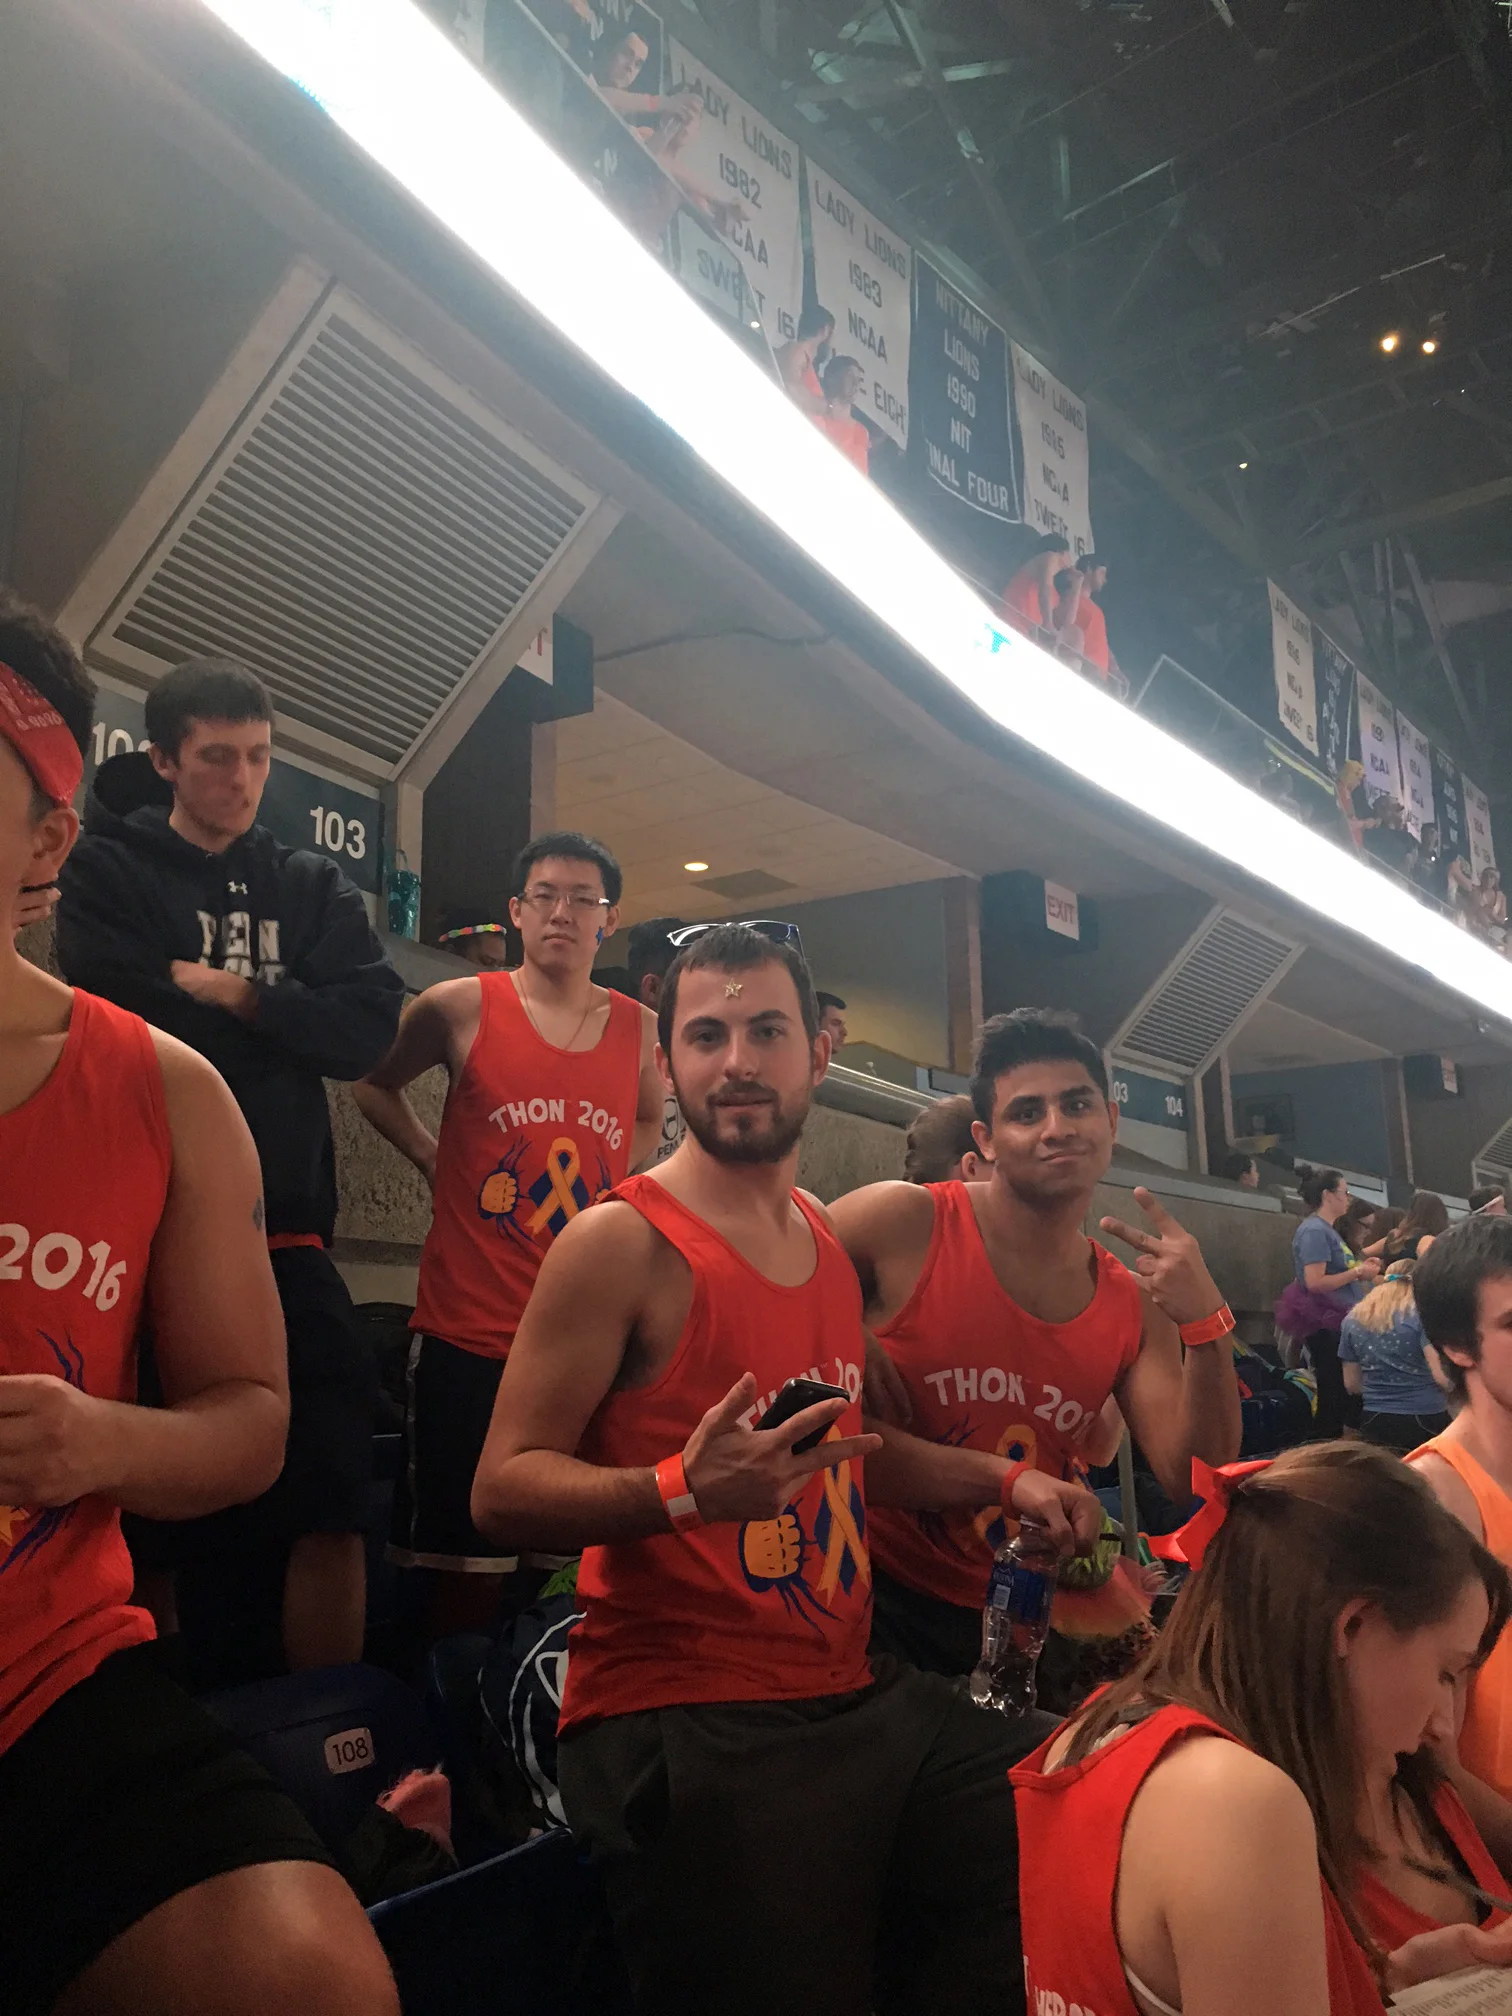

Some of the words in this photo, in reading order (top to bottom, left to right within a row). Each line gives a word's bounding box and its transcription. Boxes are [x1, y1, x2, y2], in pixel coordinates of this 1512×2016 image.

[741, 115, 792, 180] LIONS
[719, 152, 761, 209] 1982
[731, 219, 769, 270] CAA
[814, 180, 855, 235] LADY
[864, 222, 906, 280] LIONS
[848, 259, 883, 309] 1983
[777, 306, 796, 340] 16
[847, 307, 888, 364] NCAA
[936, 280, 989, 347] NITTANY
[944, 328, 980, 381] LIONS
[947, 373, 976, 418] 1990
[1053, 388, 1084, 432] LIONS
[950, 417, 972, 453] NIT
[925, 437, 960, 487] INAL
[968, 470, 1009, 512] FOUR
[92, 722, 152, 766] 10
[310, 806, 366, 860] 103
[1047, 894, 1075, 925] EXIT
[1113, 1081, 1129, 1103] 03
[1165, 1095, 1183, 1117] 104
[488, 1098, 565, 1133] THON
[577, 1100, 624, 1150] 2016
[0, 1223, 127, 1311] 2016
[924, 1367, 1026, 1406] THON
[1034, 1385, 1096, 1446] 201
[332, 1737, 369, 1765] 108
